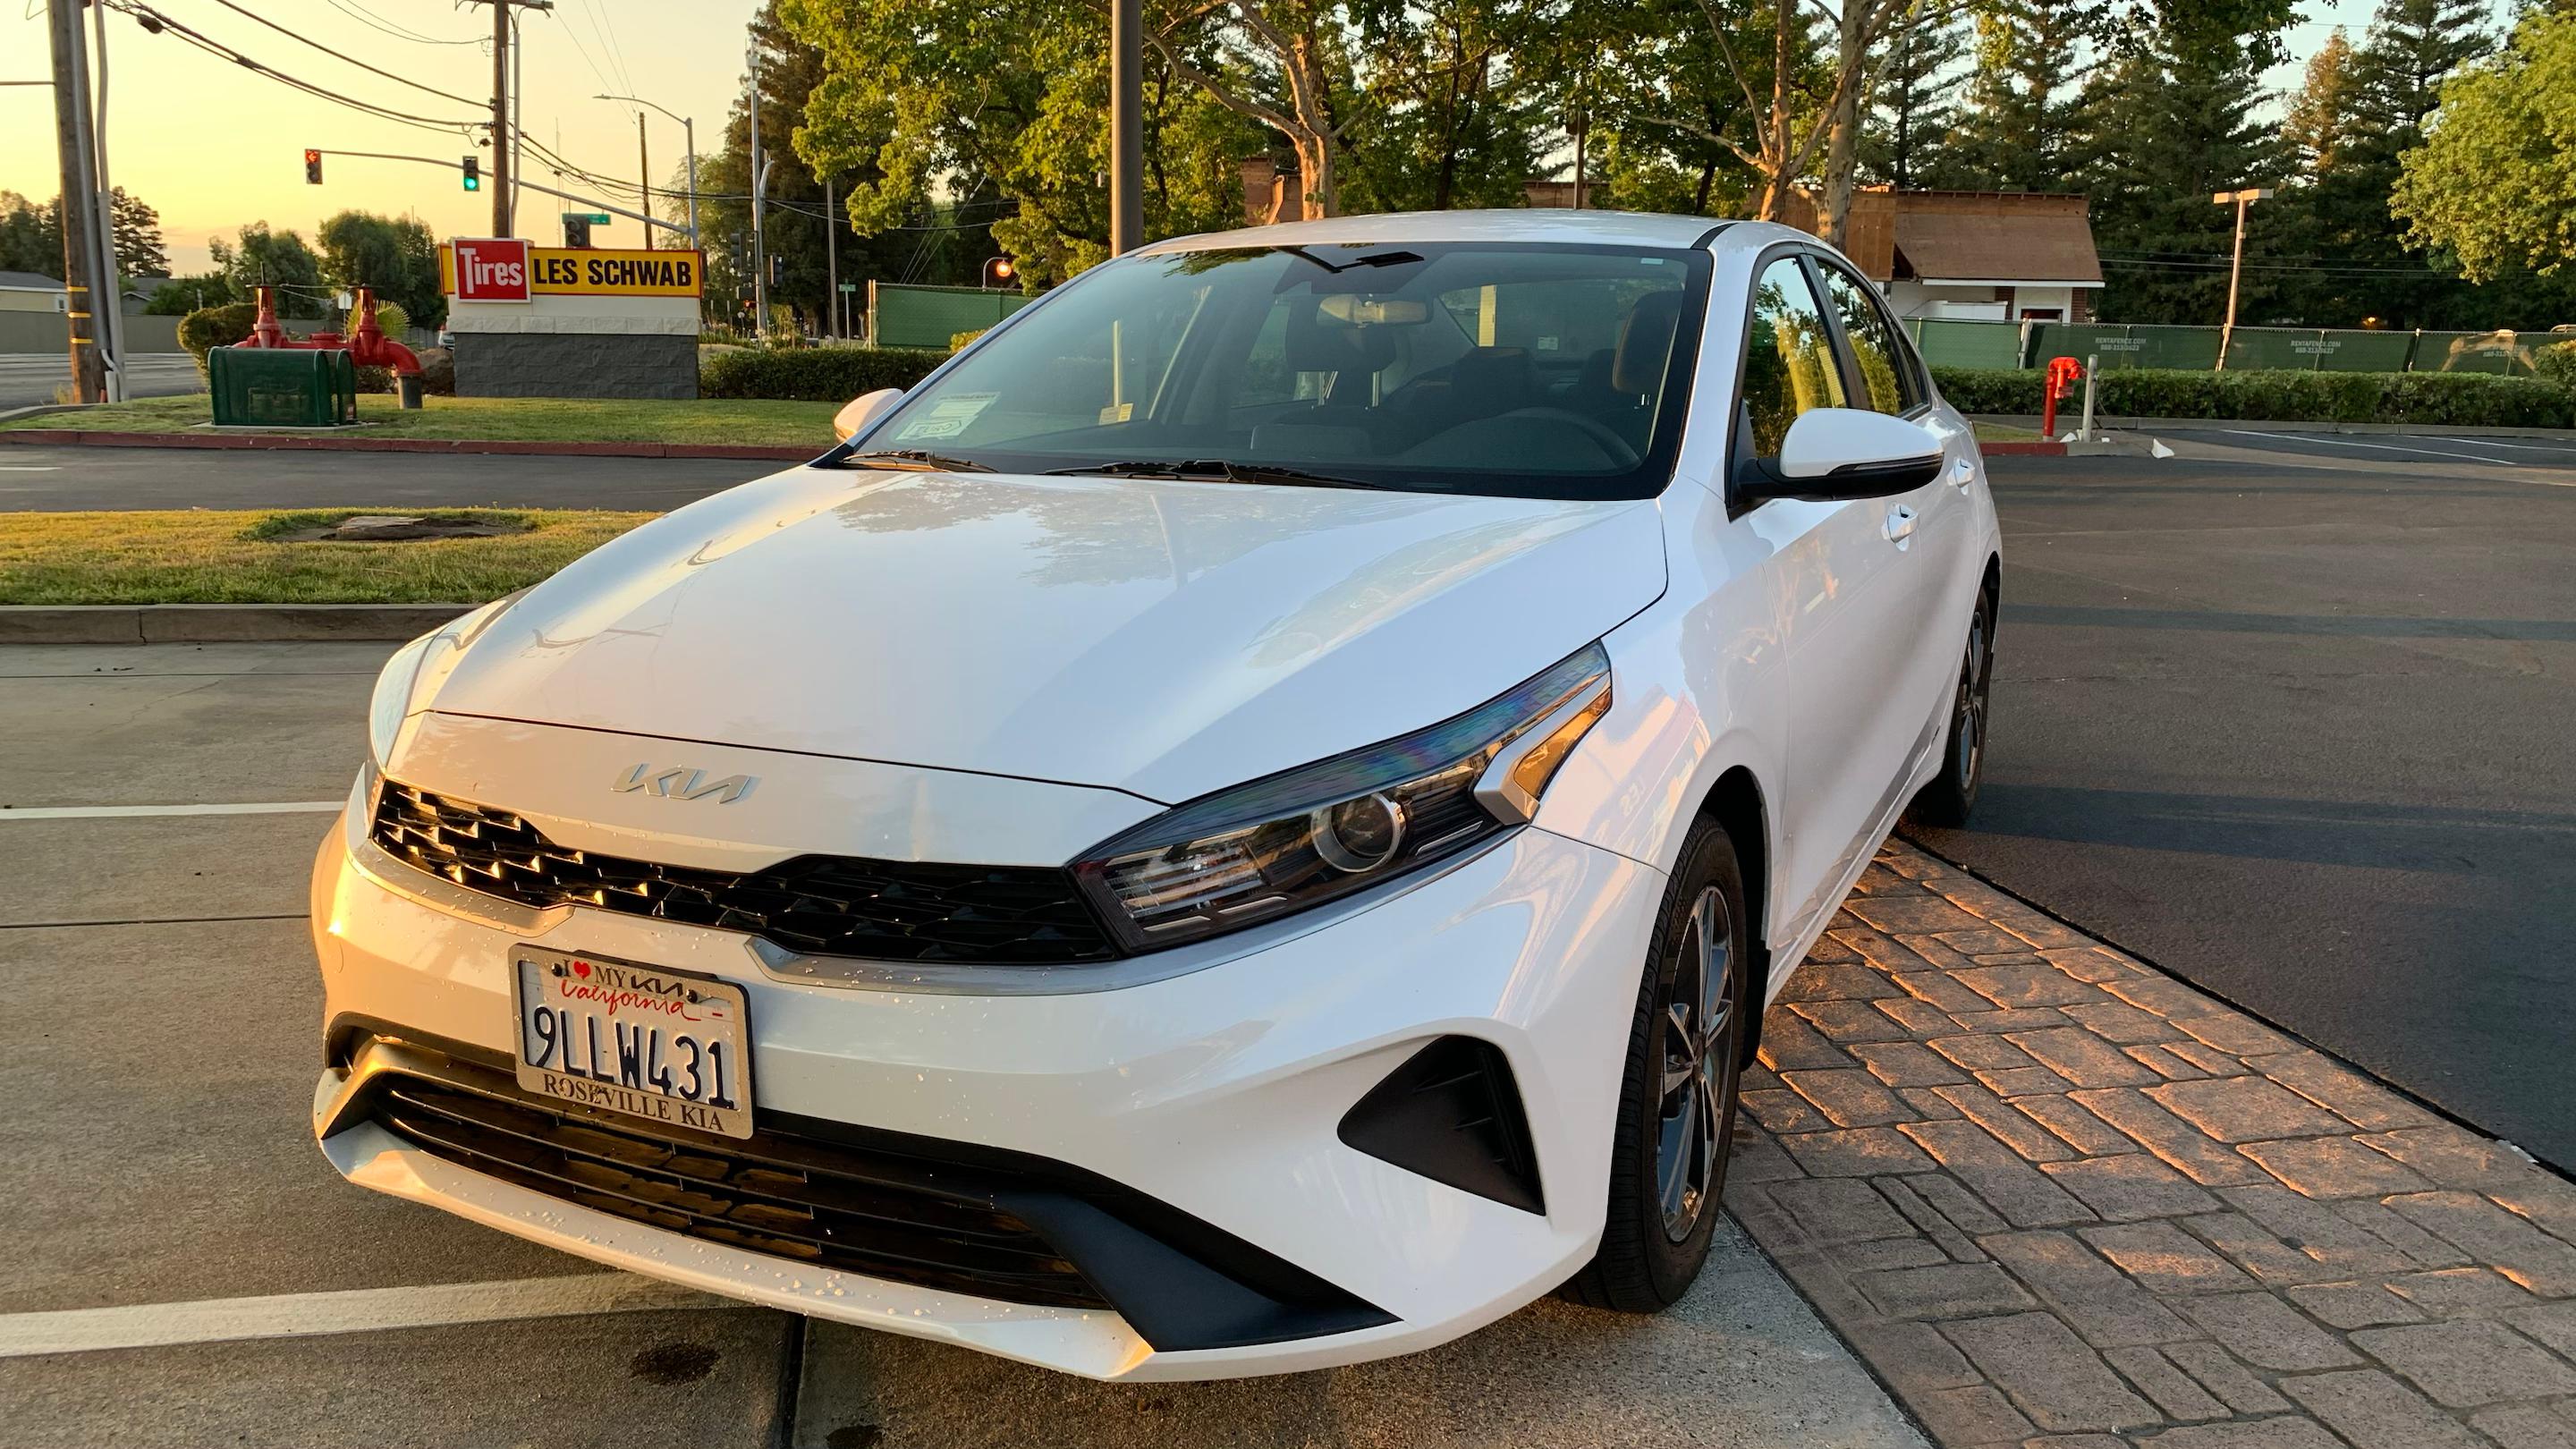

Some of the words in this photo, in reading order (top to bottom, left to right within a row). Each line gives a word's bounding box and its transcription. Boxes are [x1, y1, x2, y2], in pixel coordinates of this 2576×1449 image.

[459, 248, 522, 294] Tires
[534, 258, 579, 284] LES
[588, 259, 692, 286] SCHWAB
[594, 966, 626, 988] MY
[534, 1006, 734, 1109] 9LLW431
[543, 1073, 671, 1120] ROSEVILLE
[681, 1104, 724, 1132] KIA
